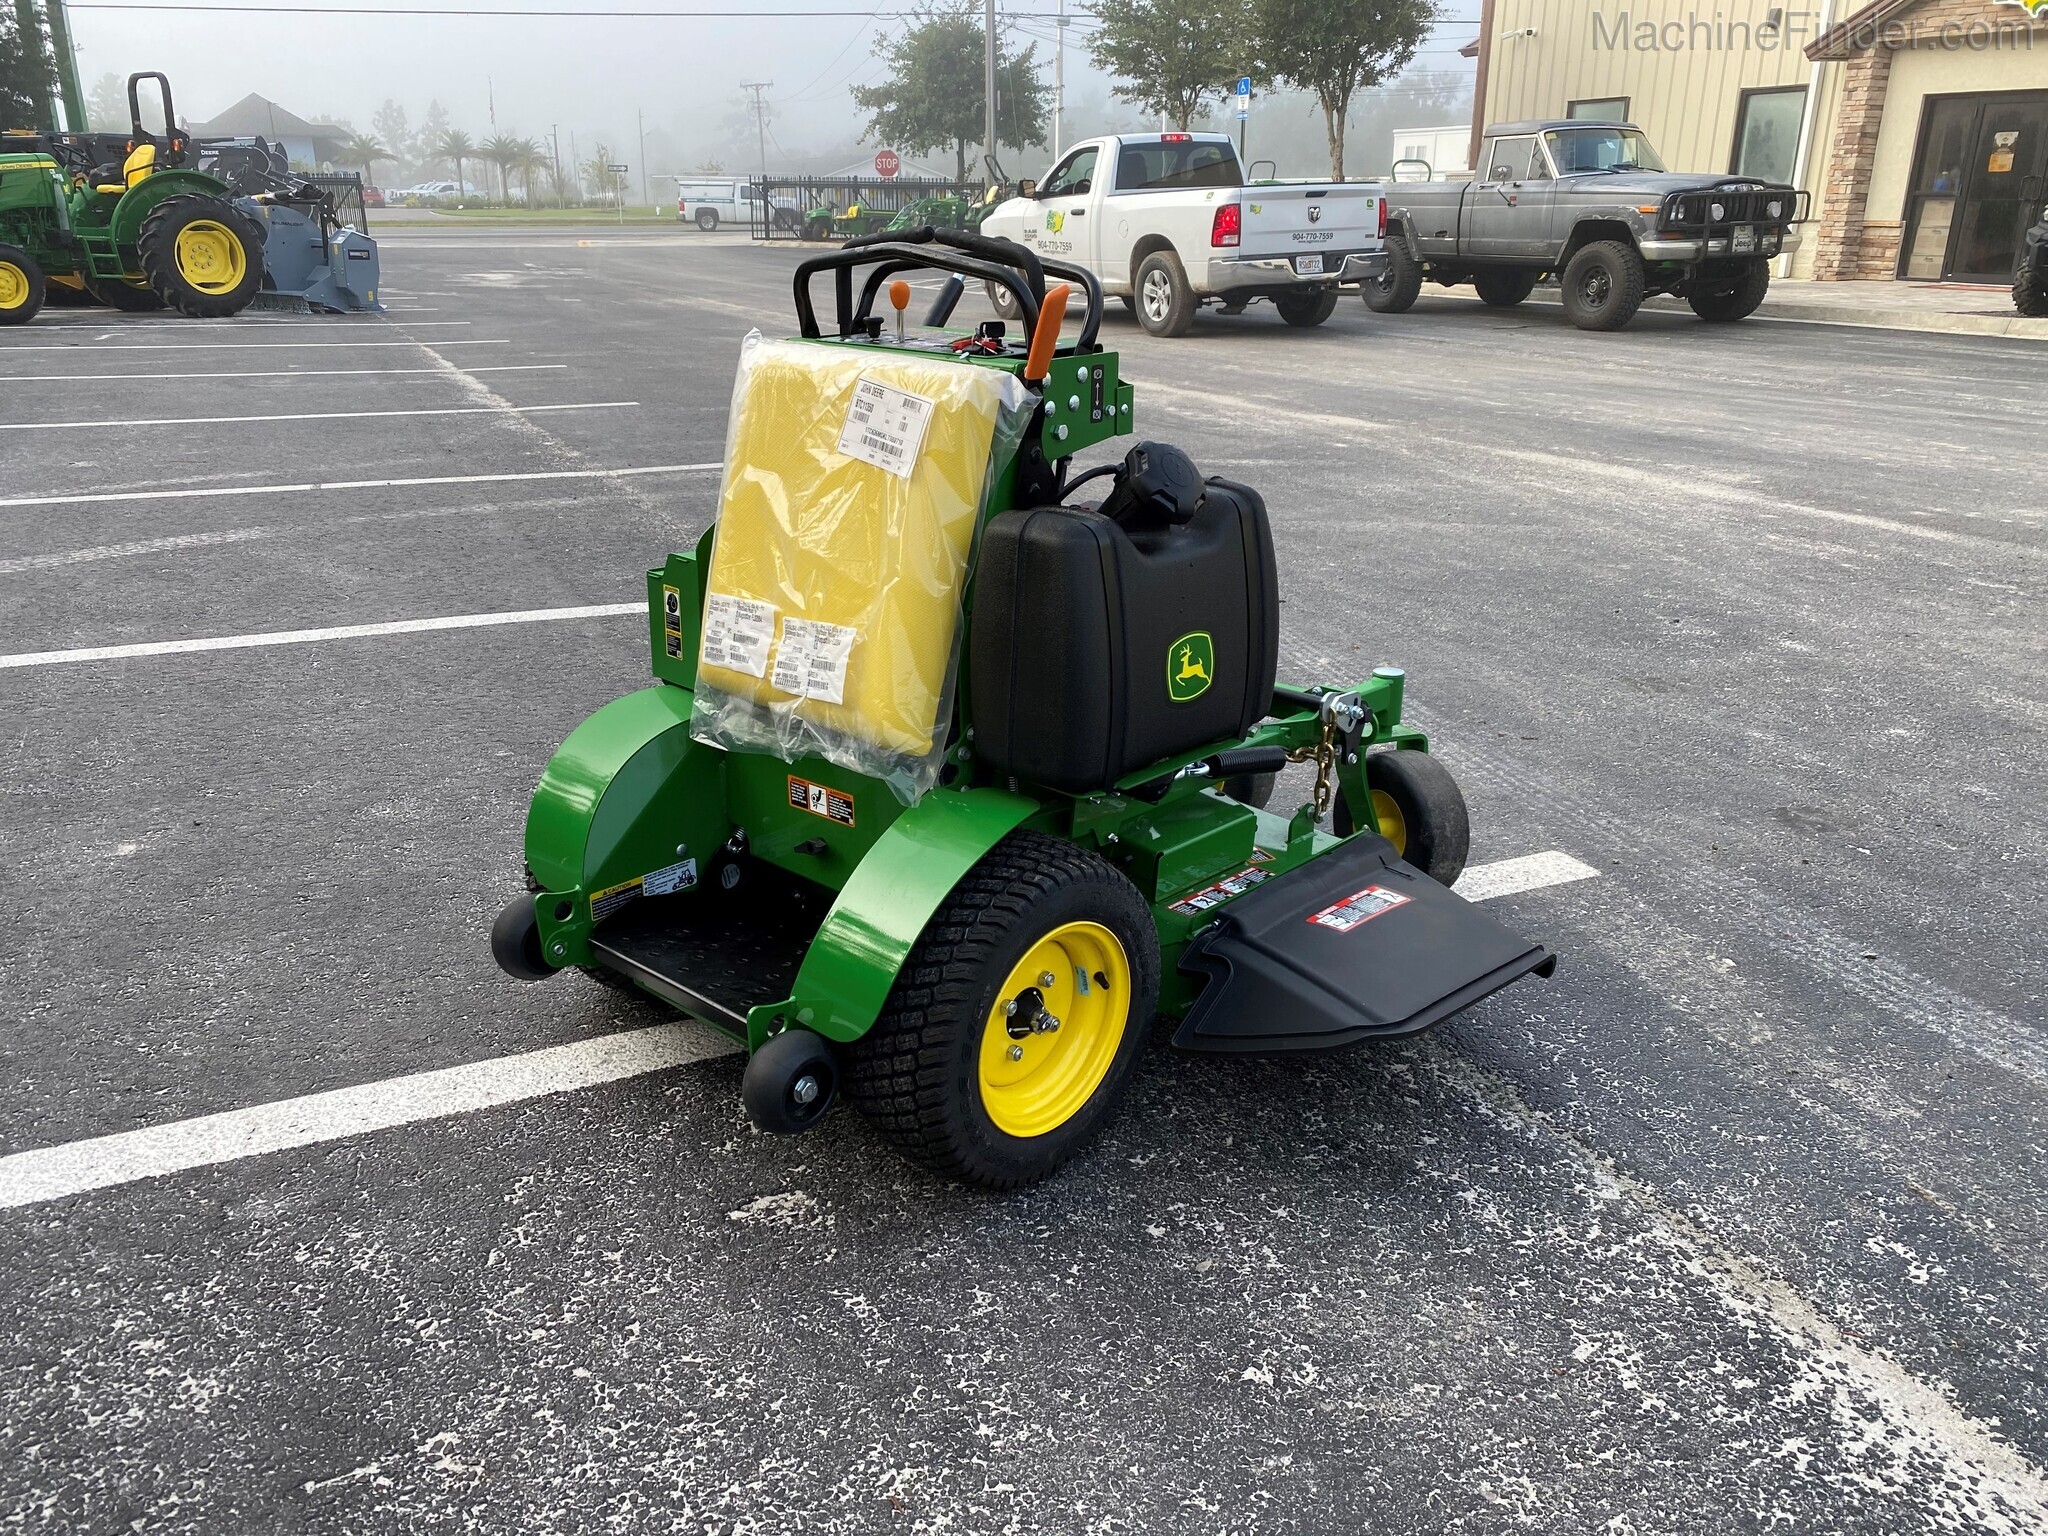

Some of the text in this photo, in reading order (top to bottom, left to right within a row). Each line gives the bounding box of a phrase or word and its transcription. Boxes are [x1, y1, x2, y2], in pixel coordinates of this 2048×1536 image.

[876, 158, 898, 169] STOP
[1292, 232, 1334, 241] 904-770-7559
[1037, 240, 1073, 252] 904-770-7559
[1734, 239, 1752, 248] Jeep
[871, 386, 884, 398] DEERE
[608, 882, 632, 893] CAUTION
